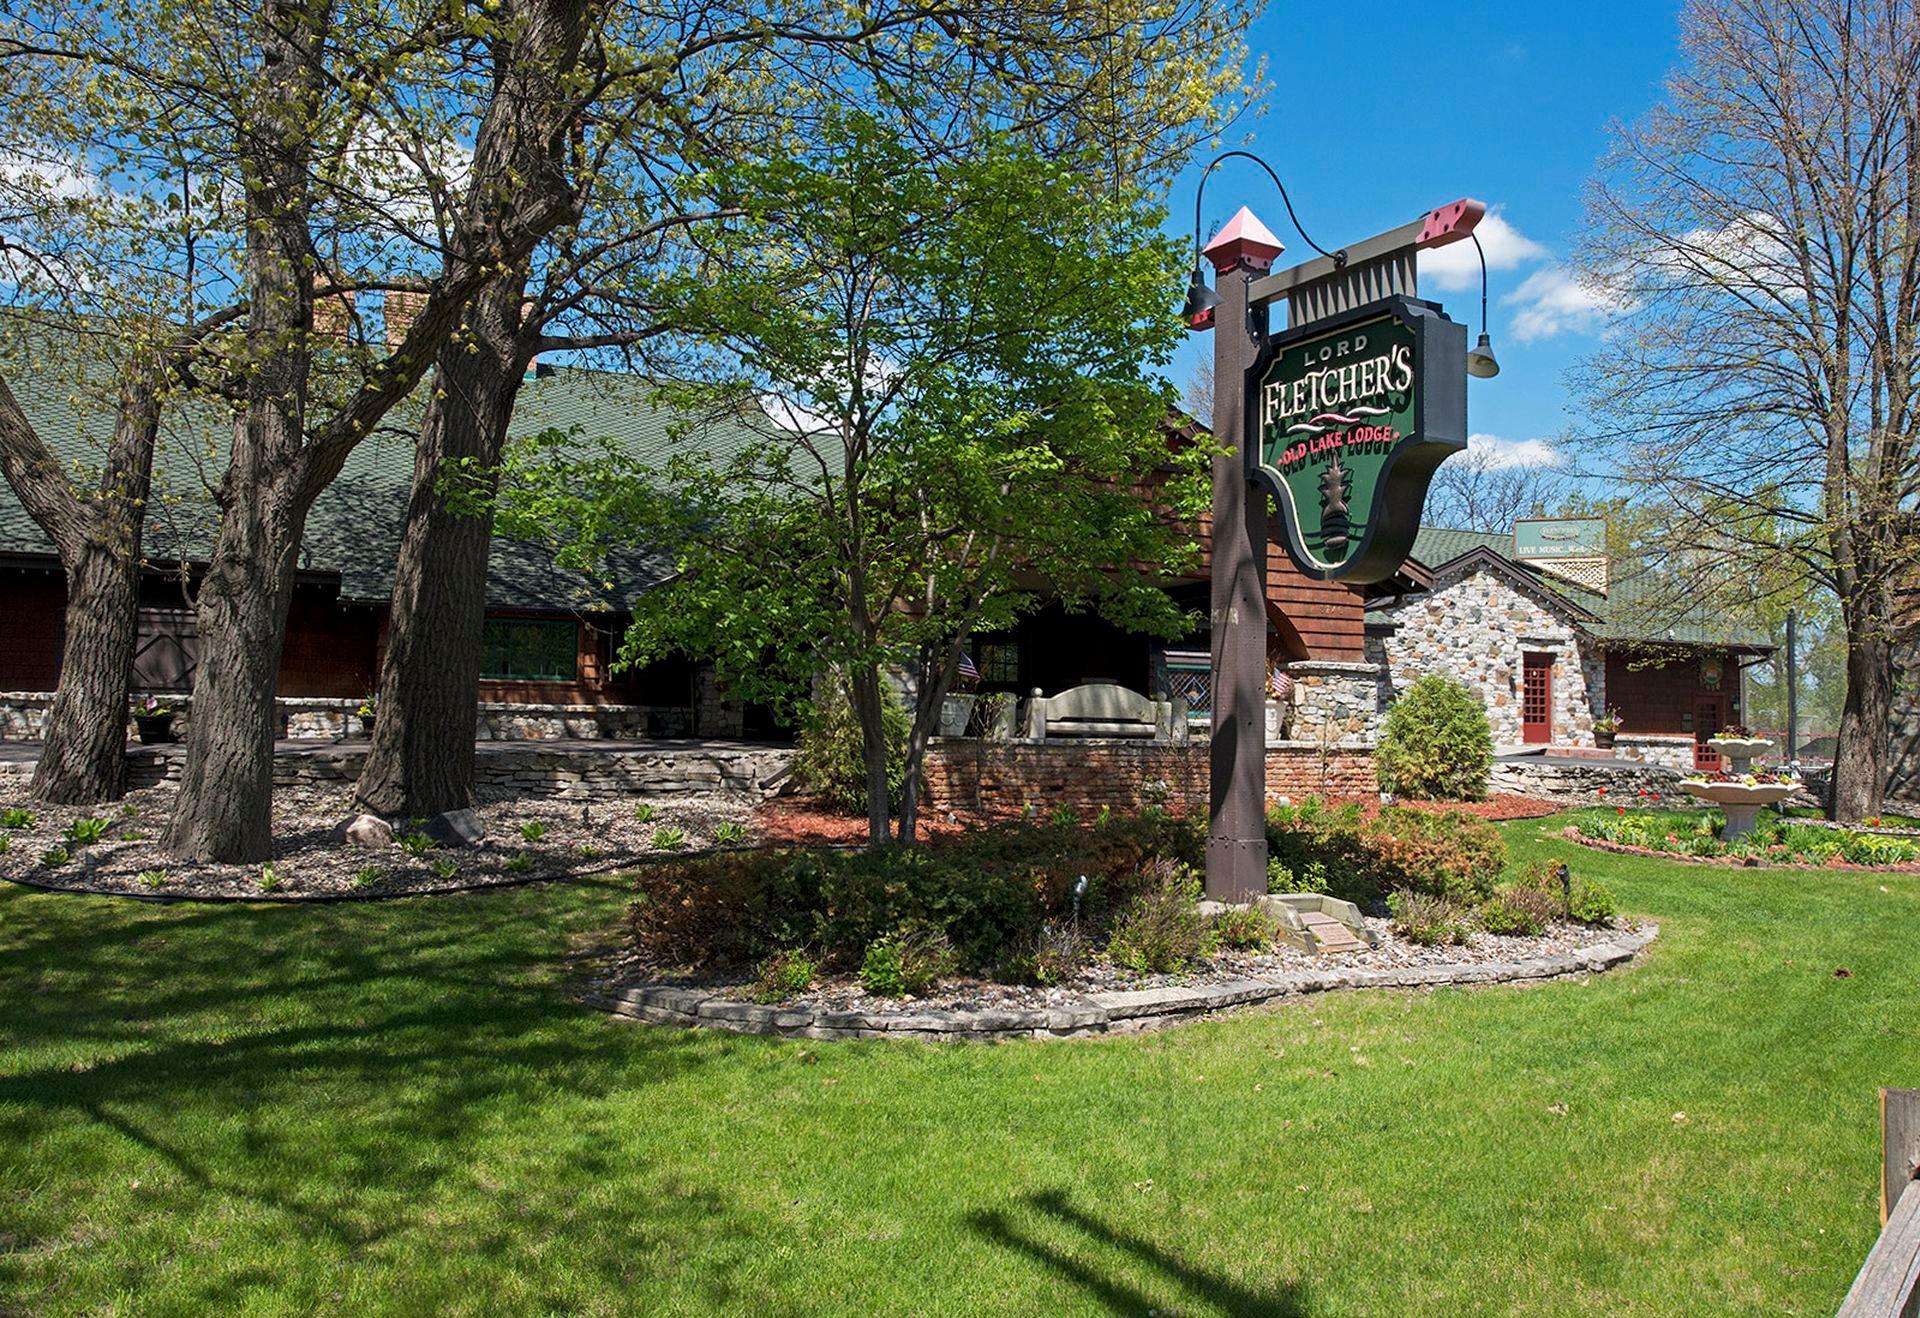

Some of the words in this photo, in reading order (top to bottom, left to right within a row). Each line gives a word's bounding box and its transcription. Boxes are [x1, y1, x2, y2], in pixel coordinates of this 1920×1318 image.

[1304, 335, 1368, 367] LORD
[1264, 344, 1412, 425] FLETCHER'S
[1282, 443, 1307, 465] OLD
[1309, 431, 1343, 454] LAKE
[1347, 426, 1392, 445] LODGE
[1519, 546, 1536, 554] LIVE
[1539, 545, 1564, 554] MUSIC
